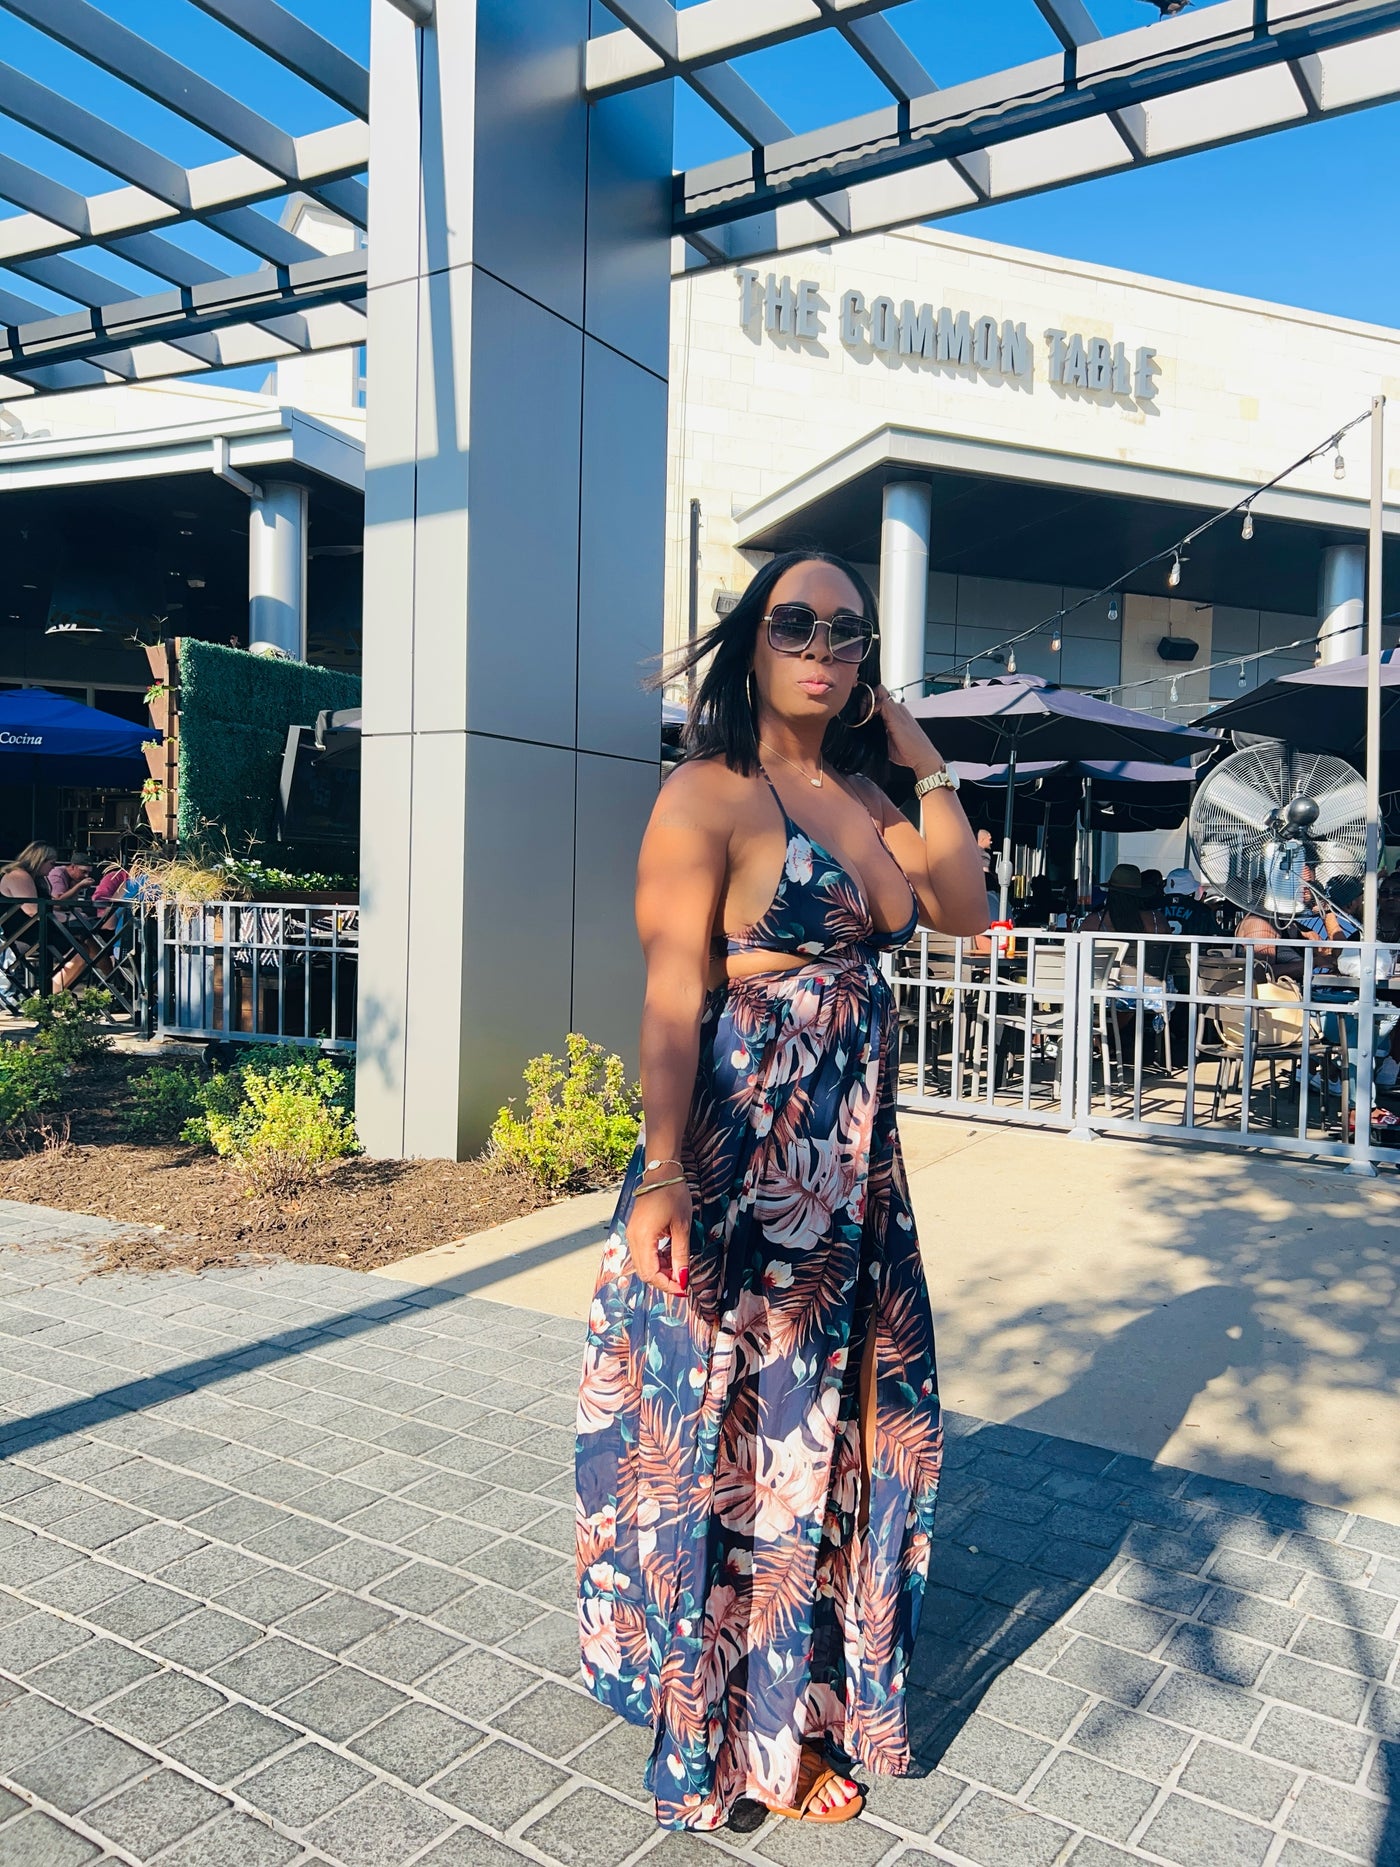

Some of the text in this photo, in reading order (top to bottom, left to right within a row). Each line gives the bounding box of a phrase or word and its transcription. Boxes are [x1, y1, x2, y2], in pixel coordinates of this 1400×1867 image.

[734, 267, 1158, 400] THE COMMON TABLE
[0, 731, 43, 745] Cocina
[1164, 905, 1193, 920] ATEN
